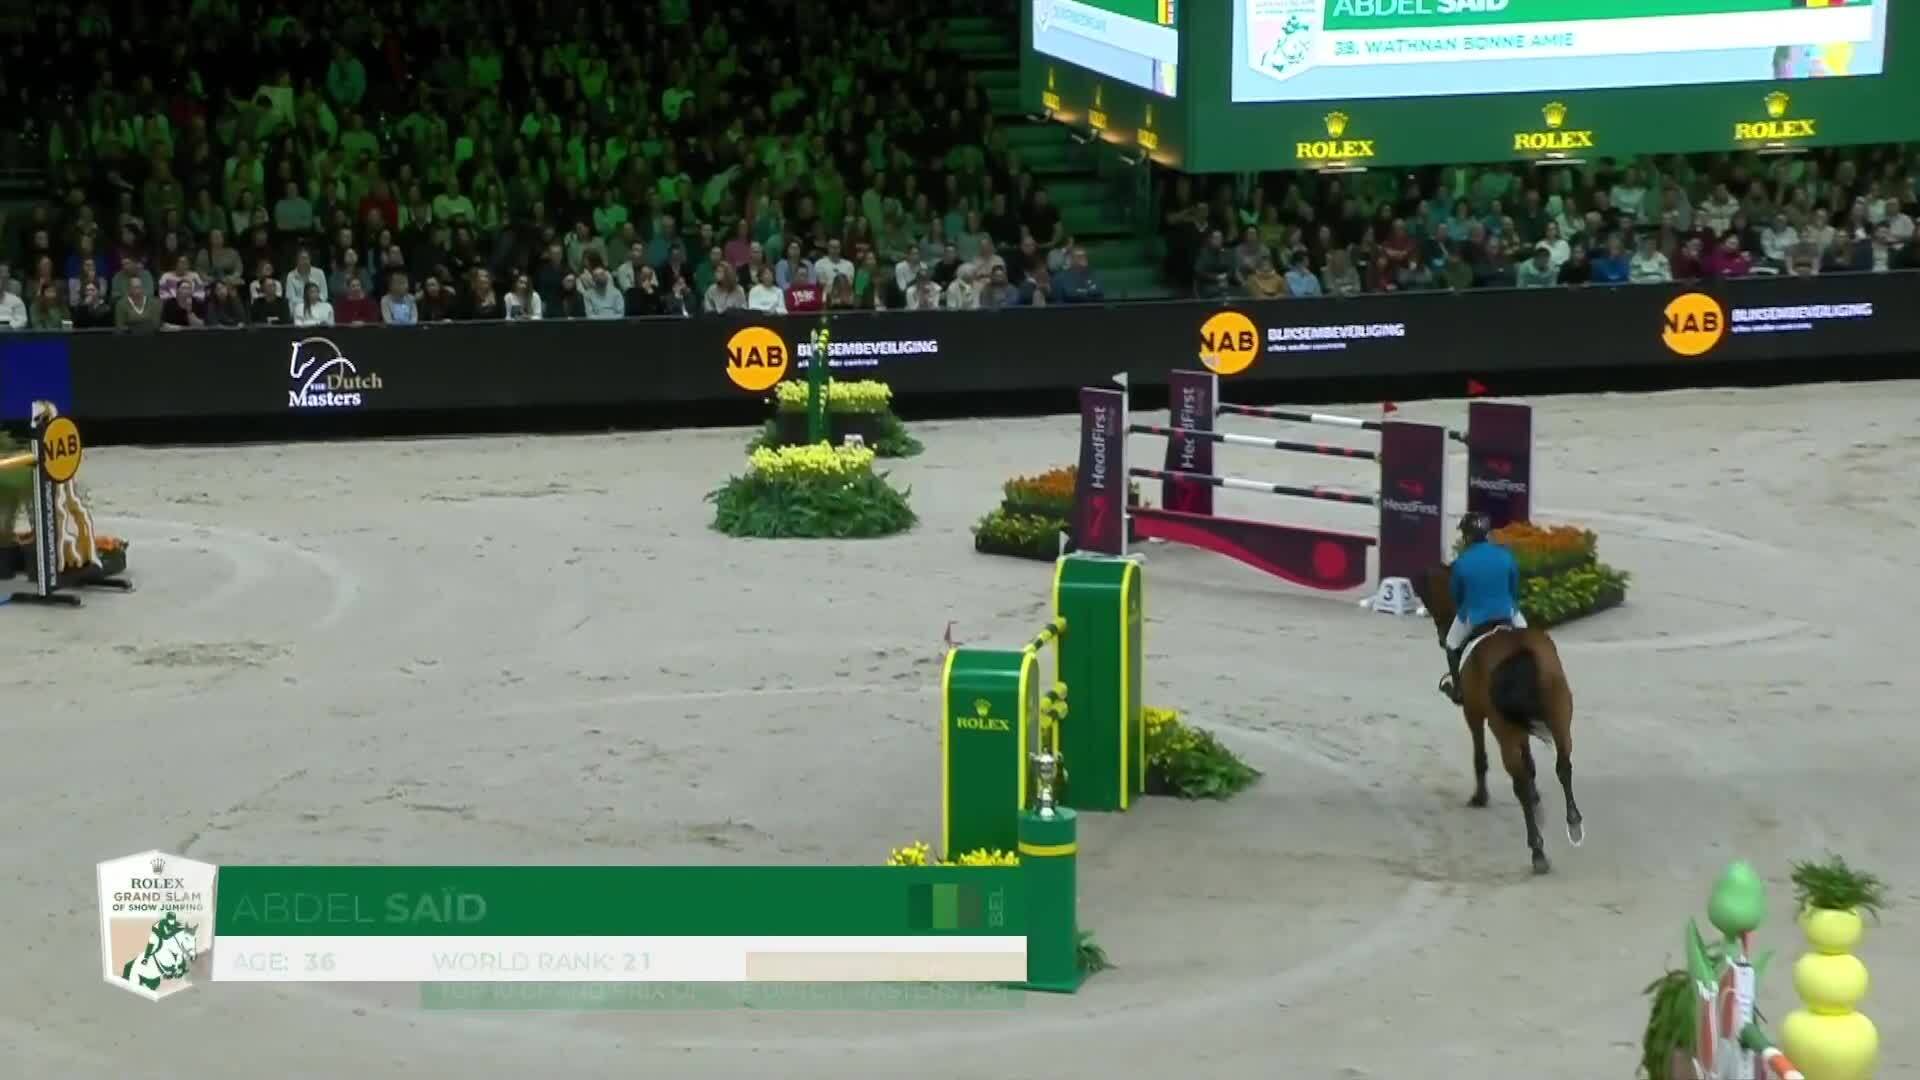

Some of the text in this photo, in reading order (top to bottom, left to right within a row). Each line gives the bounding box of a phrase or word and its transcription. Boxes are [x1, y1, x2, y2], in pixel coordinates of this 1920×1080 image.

[1735, 118, 1816, 140] ROLEX
[1296, 140, 1374, 159] ROLEX
[1514, 130, 1593, 150] ROLEX
[1666, 310, 1719, 335] NAB
[1201, 331, 1254, 353] NAB
[728, 345, 784, 368] NAB
[327, 372, 383, 390] Dutch
[288, 390, 361, 407] Masters
[44, 434, 78, 462] NAB
[1091, 406, 1107, 489] HeadFirst
[1470, 476, 1528, 493] HeadFirst
[1383, 499, 1440, 516] HeadFirst
[1383, 583, 1395, 601] 3
[956, 717, 1010, 730] ROLEX
